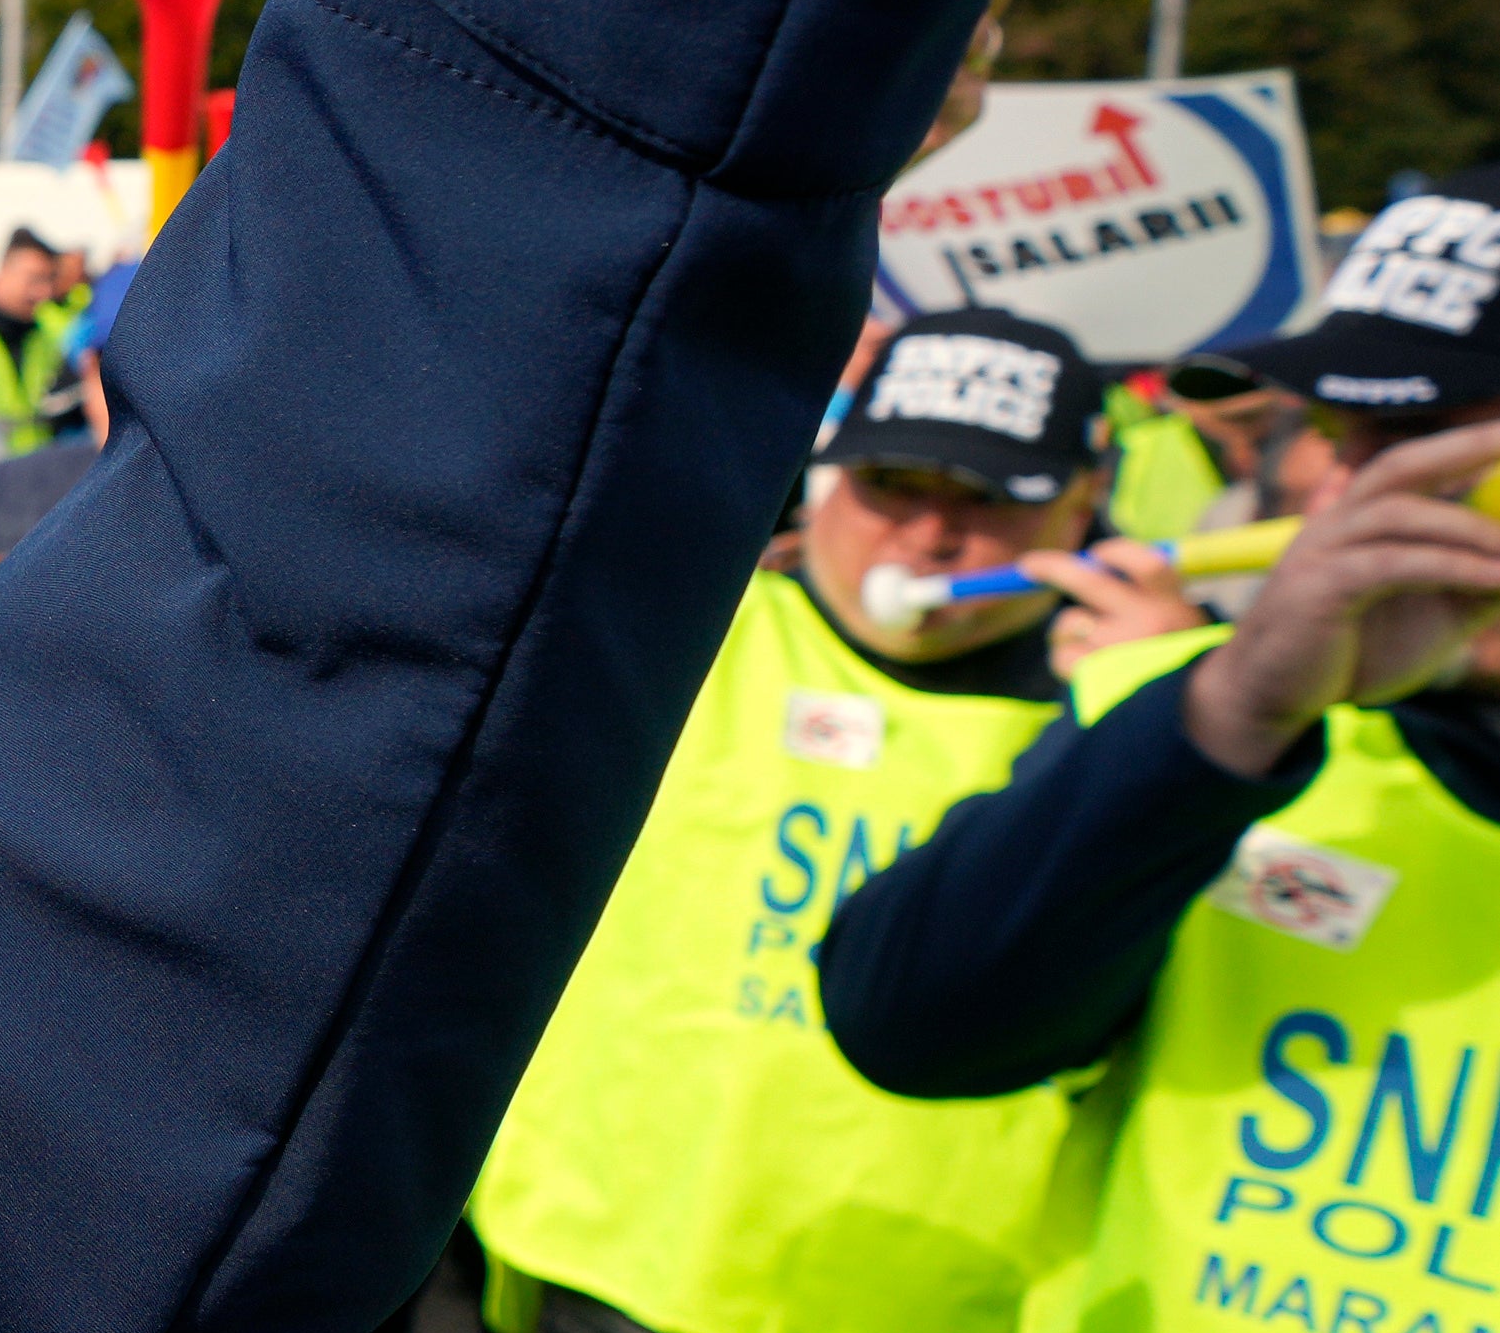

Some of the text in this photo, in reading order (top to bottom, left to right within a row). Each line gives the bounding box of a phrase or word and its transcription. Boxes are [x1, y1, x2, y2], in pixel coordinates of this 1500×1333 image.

[965, 191, 1243, 279] SALARII
[747, 920, 822, 965] P
[1214, 1175, 1497, 1294] POL
